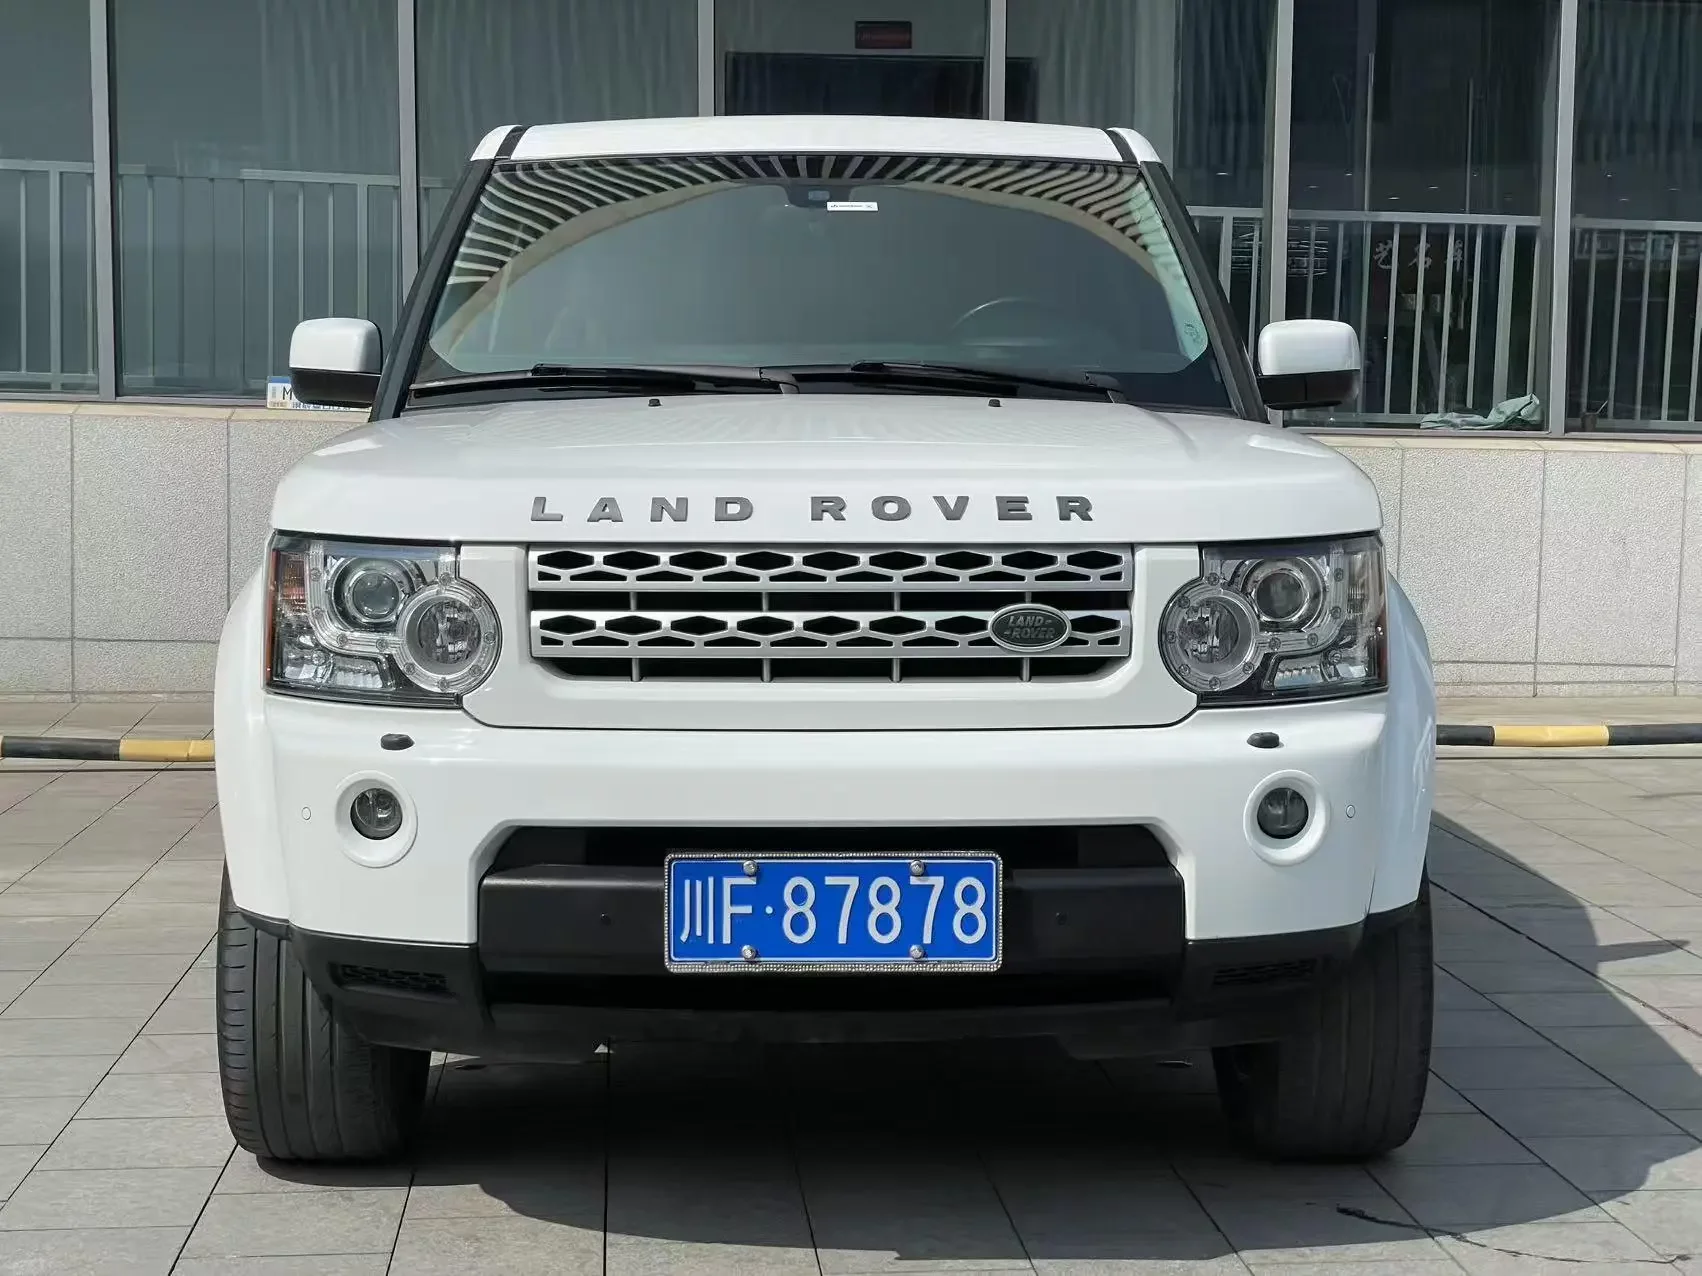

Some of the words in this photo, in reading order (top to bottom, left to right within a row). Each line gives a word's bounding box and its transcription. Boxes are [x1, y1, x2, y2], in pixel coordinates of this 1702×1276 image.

[530, 496, 754, 523] LAND
[811, 495, 1096, 523] ROVER
[680, 876, 987, 944] 川F·87878
